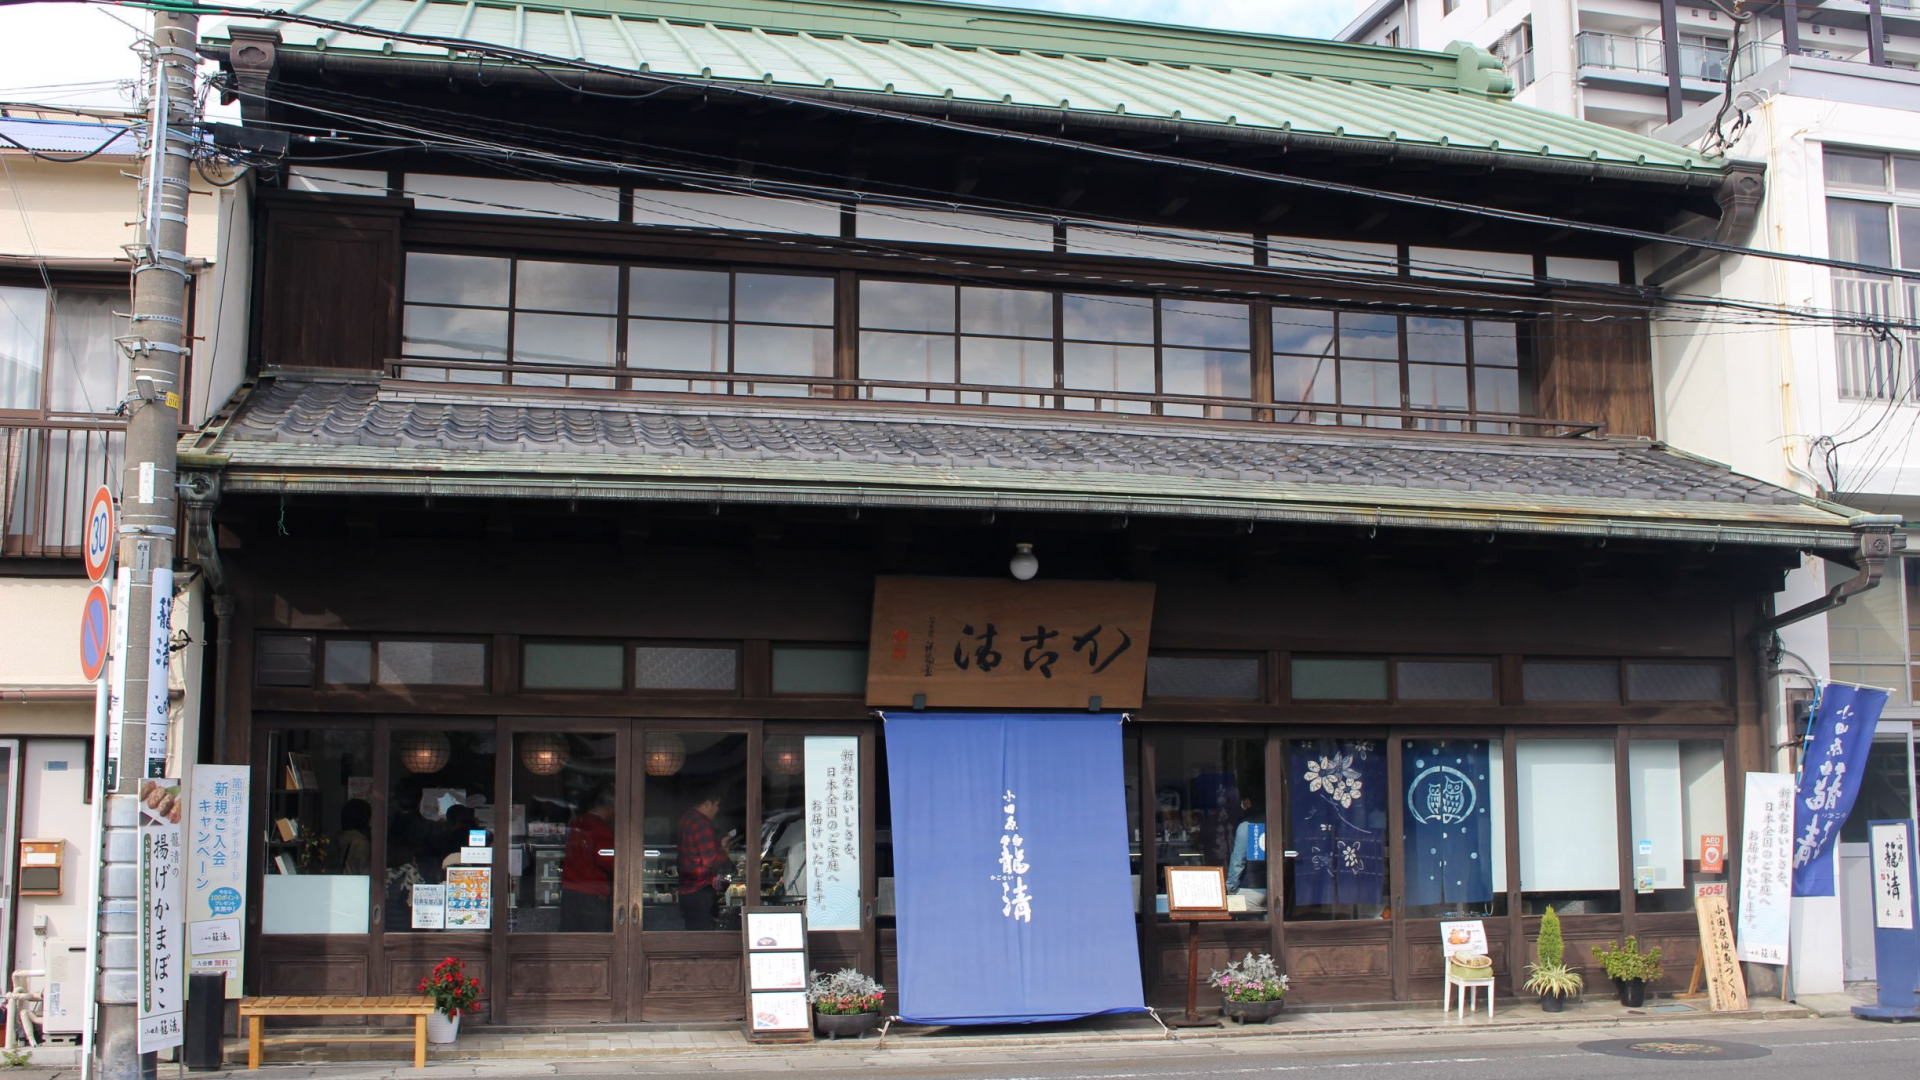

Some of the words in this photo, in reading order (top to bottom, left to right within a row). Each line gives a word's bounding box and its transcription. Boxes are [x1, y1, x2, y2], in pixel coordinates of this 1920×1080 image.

[91, 512, 107, 556] 30
[196, 799, 211, 890] キャンペーン
[213, 781, 229, 866] 新規ご入会
[231, 778, 243, 883] 籠清ポイントカード
[825, 767, 840, 883] 日本全国のご家庭へ
[841, 748, 857, 861] 新鮮なおいしさを、
[1759, 801, 1775, 906] 日本全国のご家庭へ
[1778, 787, 1791, 888] 新鮮なおいしさを、
[171, 832, 181, 878] 籠清の
[811, 800, 827, 911] お届けいたします。
[1698, 884, 1724, 897] SOS!
[1744, 831, 1759, 930] お届けいたします。
[1884, 841, 1901, 900] 籠清
[153, 833, 171, 1010] 揚げかまぼこ
[1885, 909, 1905, 918] 本店
